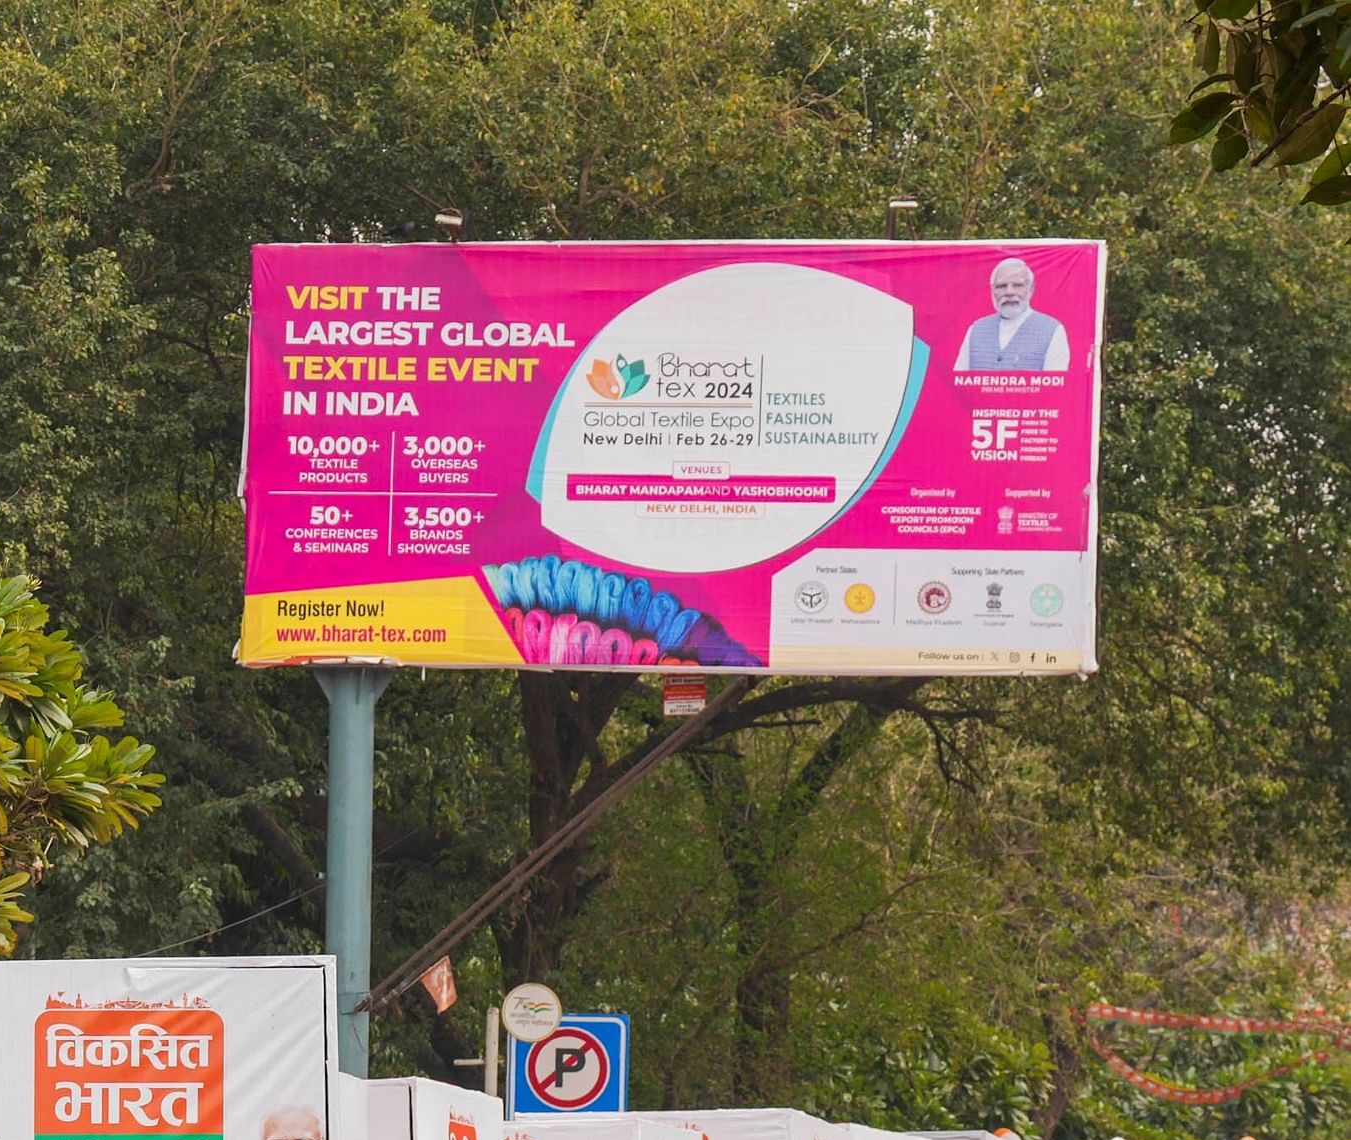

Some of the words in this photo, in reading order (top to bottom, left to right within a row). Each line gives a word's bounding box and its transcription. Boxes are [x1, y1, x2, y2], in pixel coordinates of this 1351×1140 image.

[286, 286, 369, 310] VISIT
[377, 287, 441, 310] THE
[285, 321, 433, 345] LARGEST
[441, 322, 575, 347] GLOBAL
[283, 356, 417, 381] TEXTILE
[428, 358, 539, 382] EVENT
[657, 352, 755, 378] Bharat
[954, 376, 1026, 386] NARENDRA
[1031, 376, 1064, 386] MODI
[656, 377, 696, 398] tex
[705, 382, 753, 399] 2024
[283, 391, 317, 415] IN
[326, 392, 419, 416] INDIA
[766, 393, 825, 406] TEXTILES
[766, 413, 832, 425] FASHION
[973, 409, 1020, 418] INSPIRED
[1023, 410, 1036, 418] BY
[1038, 410, 1058, 418] THE
[583, 411, 645, 428] Global
[651, 411, 705, 428] Textile
[711, 413, 754, 431] Expo
[583, 433, 617, 445] New
[624, 433, 662, 445] Delhi
[676, 433, 705, 445] Feb
[710, 434, 753, 446] 26-29
[765, 431, 878, 445] SUSTAINABILITY
[971, 419, 1019, 449] 5F
[288, 435, 380, 458] 10,000+
[403, 436, 486, 458] 3,000+
[971, 451, 1017, 461] VISION
[310, 458, 358, 469] TEXTILE
[411, 459, 478, 469] OVERSEAS
[680, 466, 722, 474] VENUES
[299, 472, 368, 483] PRODUCTS
[419, 473, 469, 483] BUYERS
[576, 484, 627, 496] BHARAT
[733, 486, 828, 497] YASHOBHOOMI
[310, 506, 353, 525] 50+
[646, 504, 676, 513] NEW
[679, 504, 719, 515] DELHI,
[722, 504, 757, 514] INDIA
[404, 507, 484, 528] 3,500+
[891, 516, 924, 524] EXPORT
[285, 528, 378, 539] CONFERENCES
[410, 529, 463, 540] BRANDS
[293, 543, 302, 552] &
[305, 543, 369, 553] SEMINARS
[397, 543, 470, 554] SHOWCASE
[278, 600, 341, 620] Register
[347, 600, 384, 617] Now!
[277, 624, 446, 642] www.bharat-tex.com
[918, 652, 949, 661] Follow
[46, 1023, 213, 1070] विकसित
[555, 1048, 586, 1088] P
[54, 1081, 204, 1127] भारत
